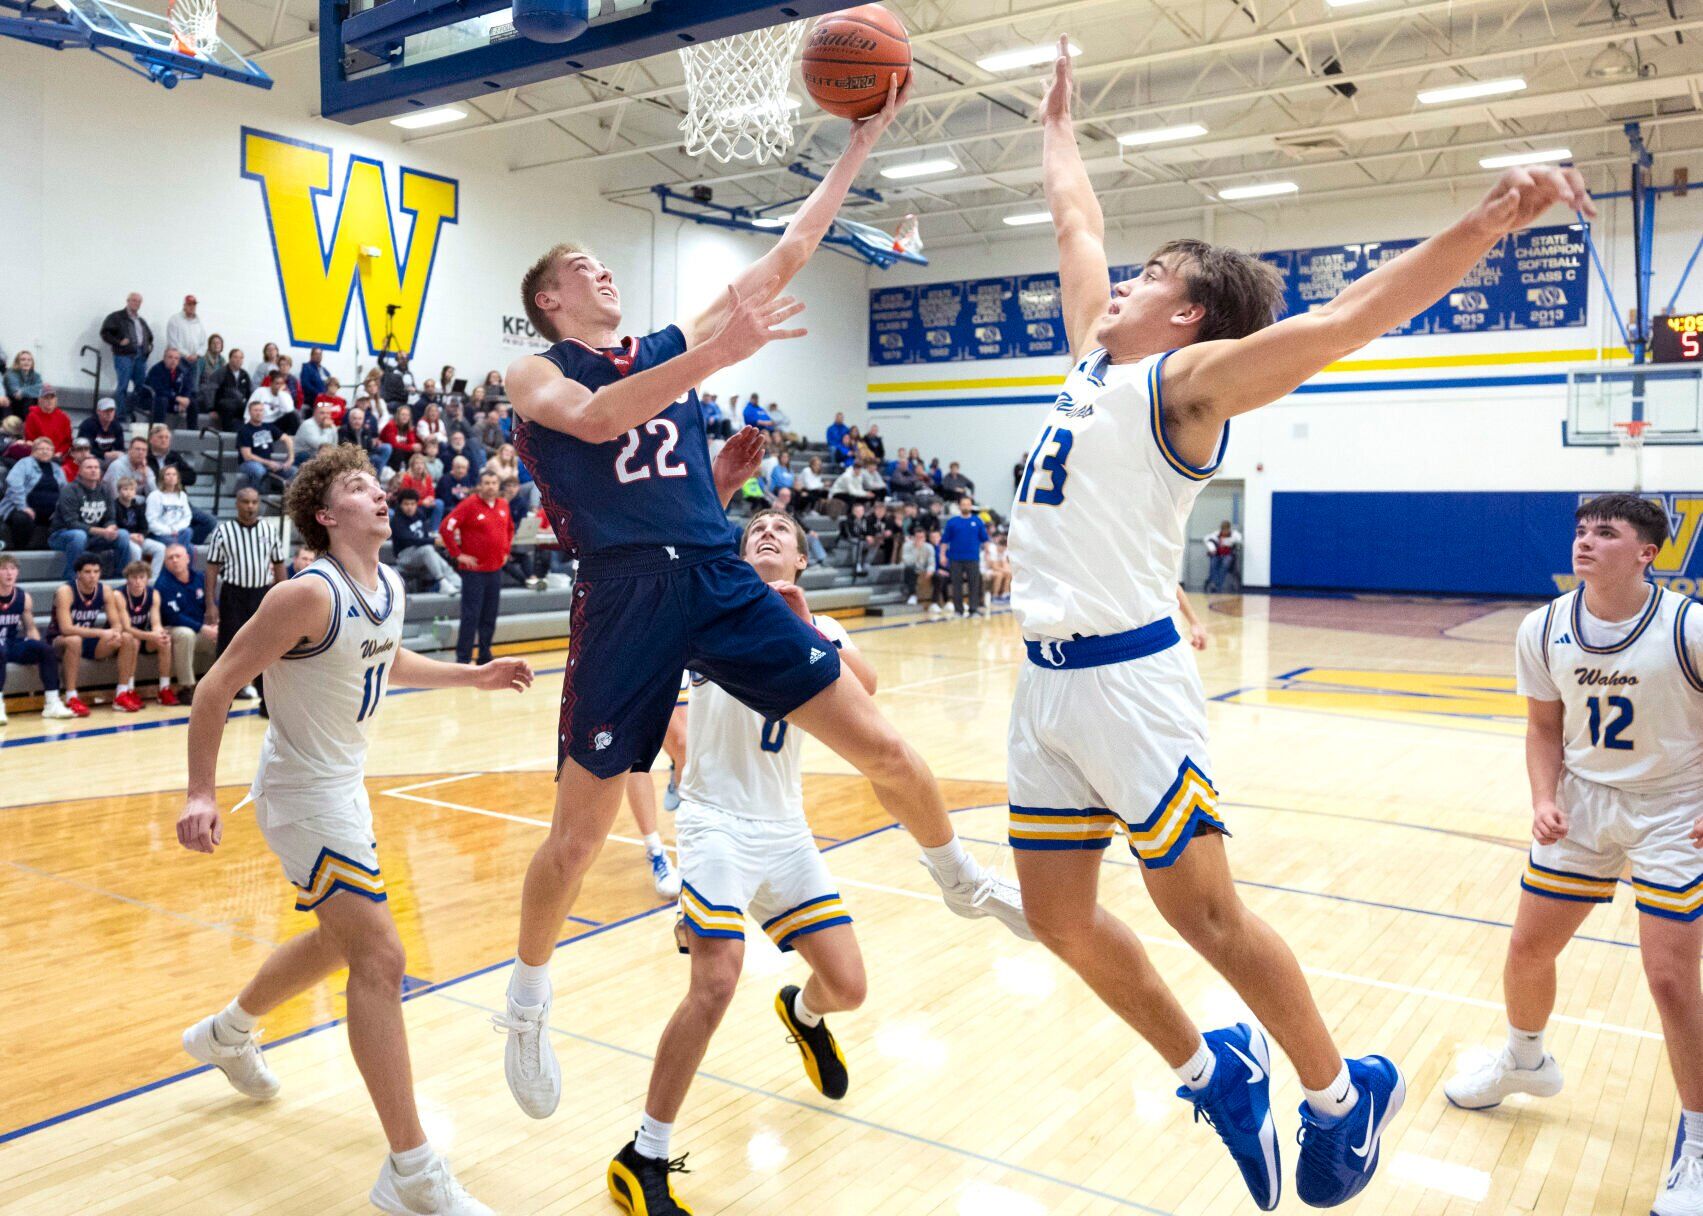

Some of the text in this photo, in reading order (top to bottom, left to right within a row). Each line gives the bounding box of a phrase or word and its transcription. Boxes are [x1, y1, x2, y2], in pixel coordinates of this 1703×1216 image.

[240, 126, 459, 359] W
[1532, 234, 1568, 246] STATE
[1515, 243, 1584, 258] CHAMPION
[1518, 256, 1581, 270] SOFTBALL
[1521, 269, 1577, 284] CLASS C
[1453, 313, 1485, 325] 2013
[1530, 309, 1564, 321] 2013
[502, 315, 541, 337] KFO
[614, 417, 688, 484] 22
[1019, 425, 1073, 506] 13
[1574, 667, 1640, 686] Wahoo
[356, 662, 386, 723] 11
[1586, 694, 1635, 751] 12
